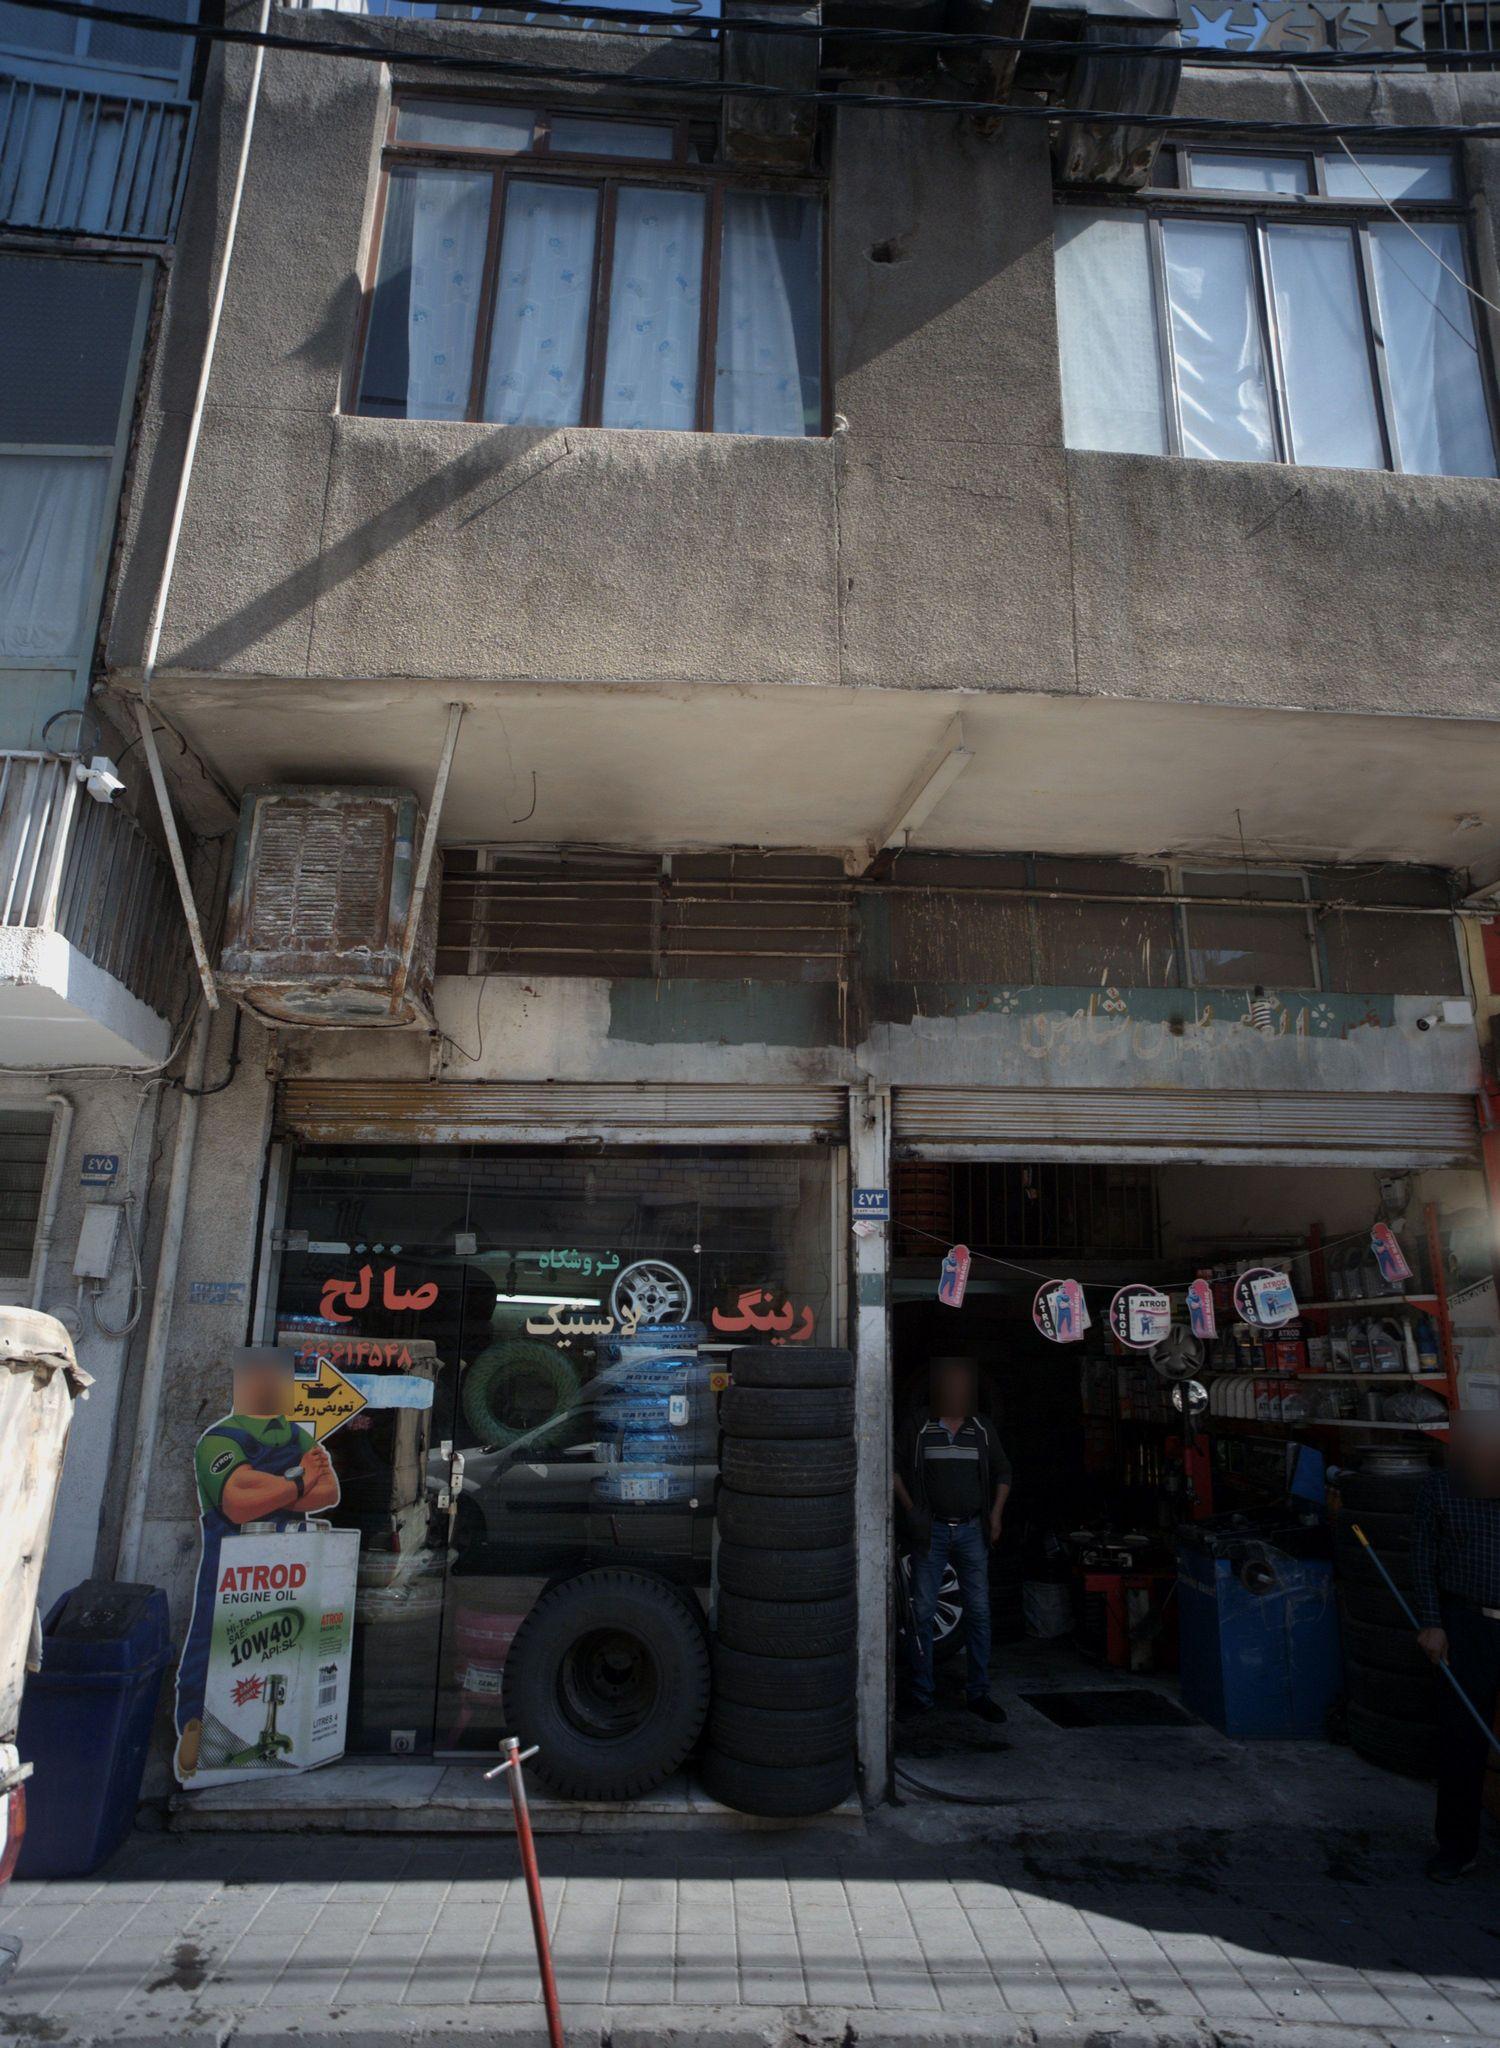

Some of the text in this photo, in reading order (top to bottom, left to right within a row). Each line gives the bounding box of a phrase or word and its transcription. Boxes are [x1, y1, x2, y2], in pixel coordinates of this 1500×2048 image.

[319, 1264, 440, 1323] صالح
[1262, 1279, 1287, 1289] ATROD
[712, 1288, 816, 1344] رینگ
[1039, 1297, 1054, 1336] ATROD
[1118, 1296, 1127, 1337] ATROD
[1139, 1300, 1167, 1308] ATROD
[1241, 1284, 1257, 1322] ATROD
[526, 1301, 642, 1347] لاستیک
[317, 1401, 354, 1416] تعویض
[219, 1563, 307, 1592] ATROD
[222, 1590, 297, 1605] ENGINE OIL
[226, 1610, 262, 1636] Hi-Tech
[321, 1612, 344, 1626] ATROD
[230, 1616, 293, 1668] 10W40
[313, 1714, 334, 1729] LITRES
